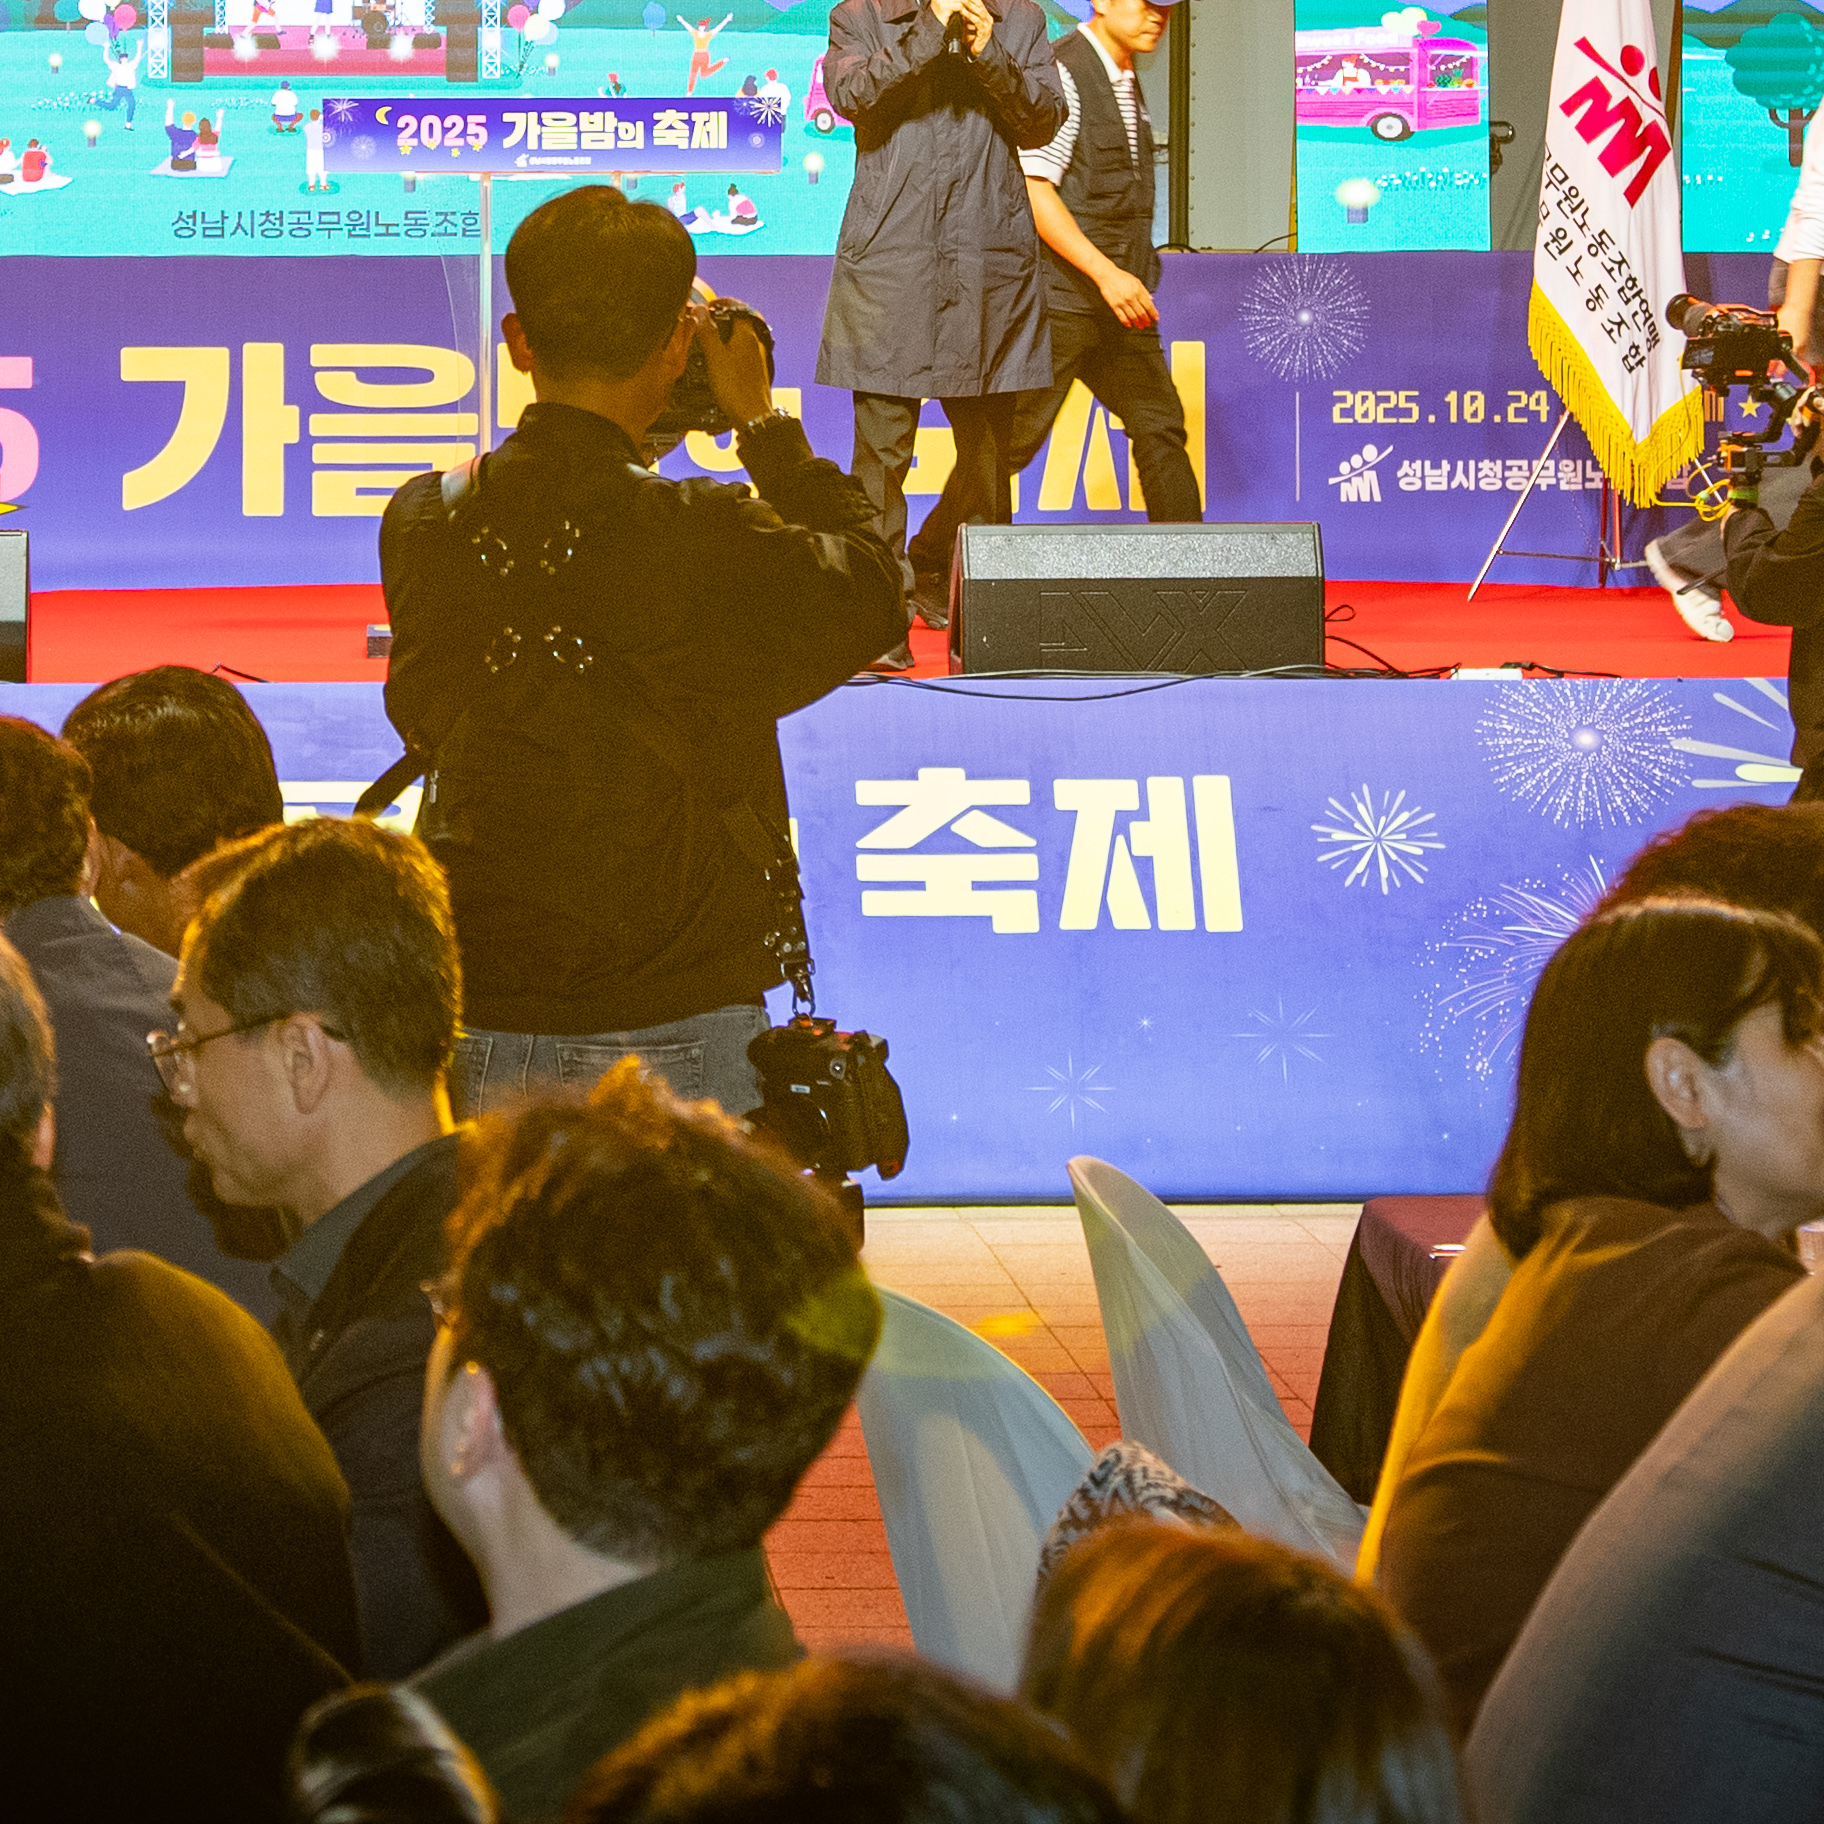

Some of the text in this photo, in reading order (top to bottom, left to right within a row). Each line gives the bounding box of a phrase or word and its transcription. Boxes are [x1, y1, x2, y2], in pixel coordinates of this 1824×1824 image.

[396, 109, 728, 150] 2025 가을밤의 축제
[854, 767, 1244, 933] 축제
